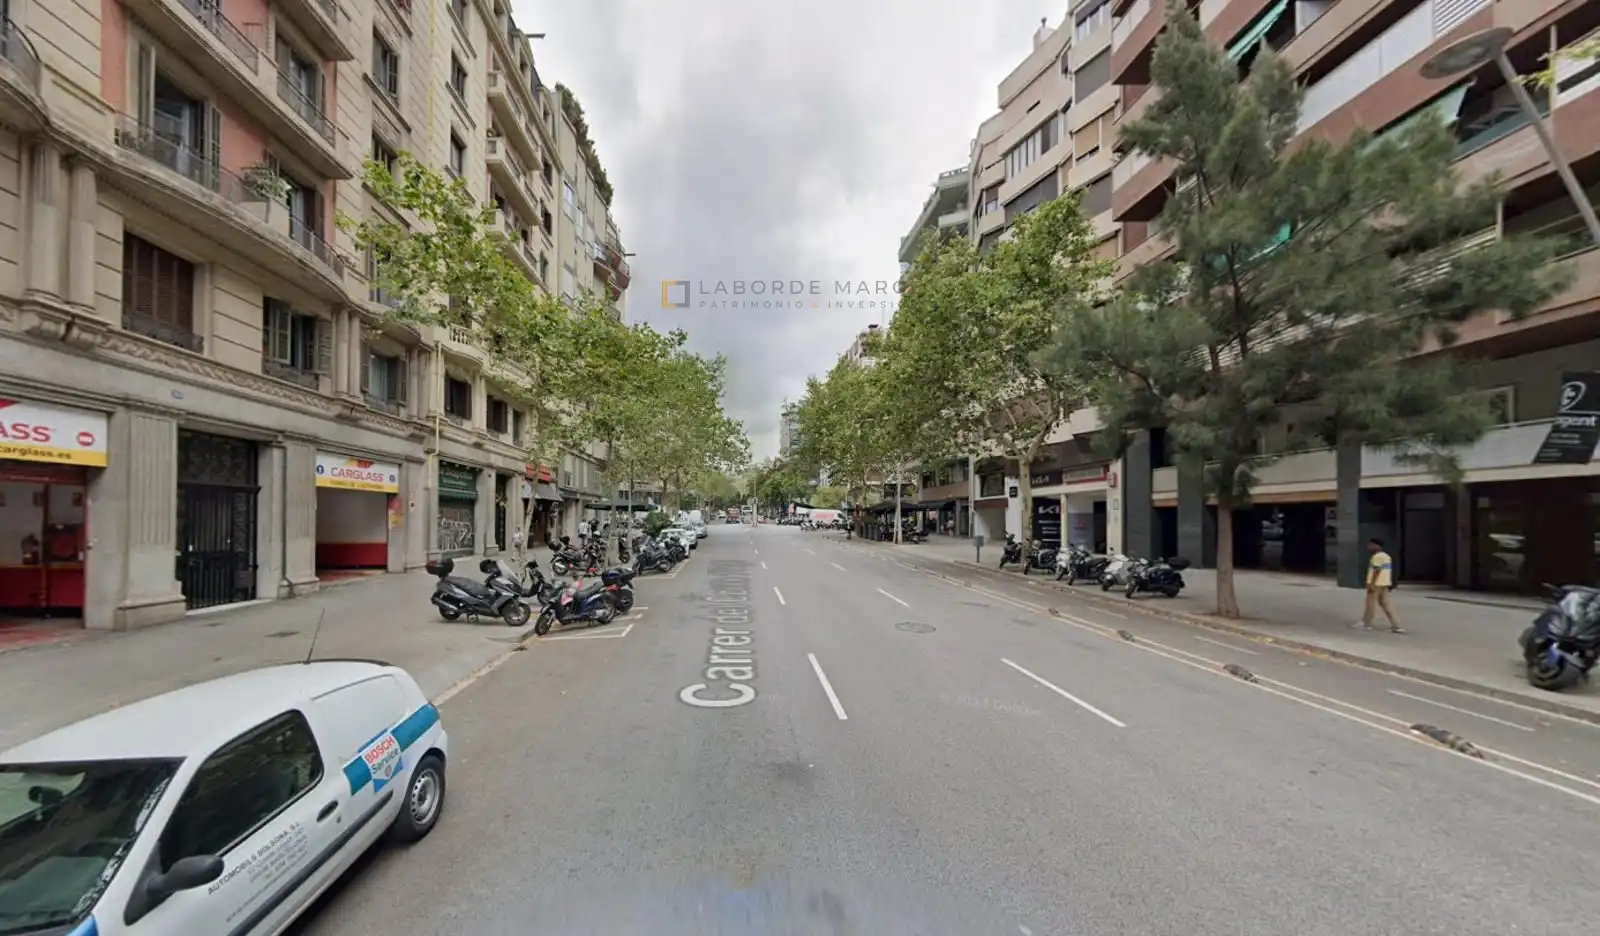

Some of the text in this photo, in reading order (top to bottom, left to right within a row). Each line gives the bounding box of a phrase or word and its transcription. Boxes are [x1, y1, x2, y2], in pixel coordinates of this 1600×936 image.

[330, 467, 385, 483] CARGLASS
[364, 736, 395, 764] BOSCH
[371, 748, 399, 774] Service
